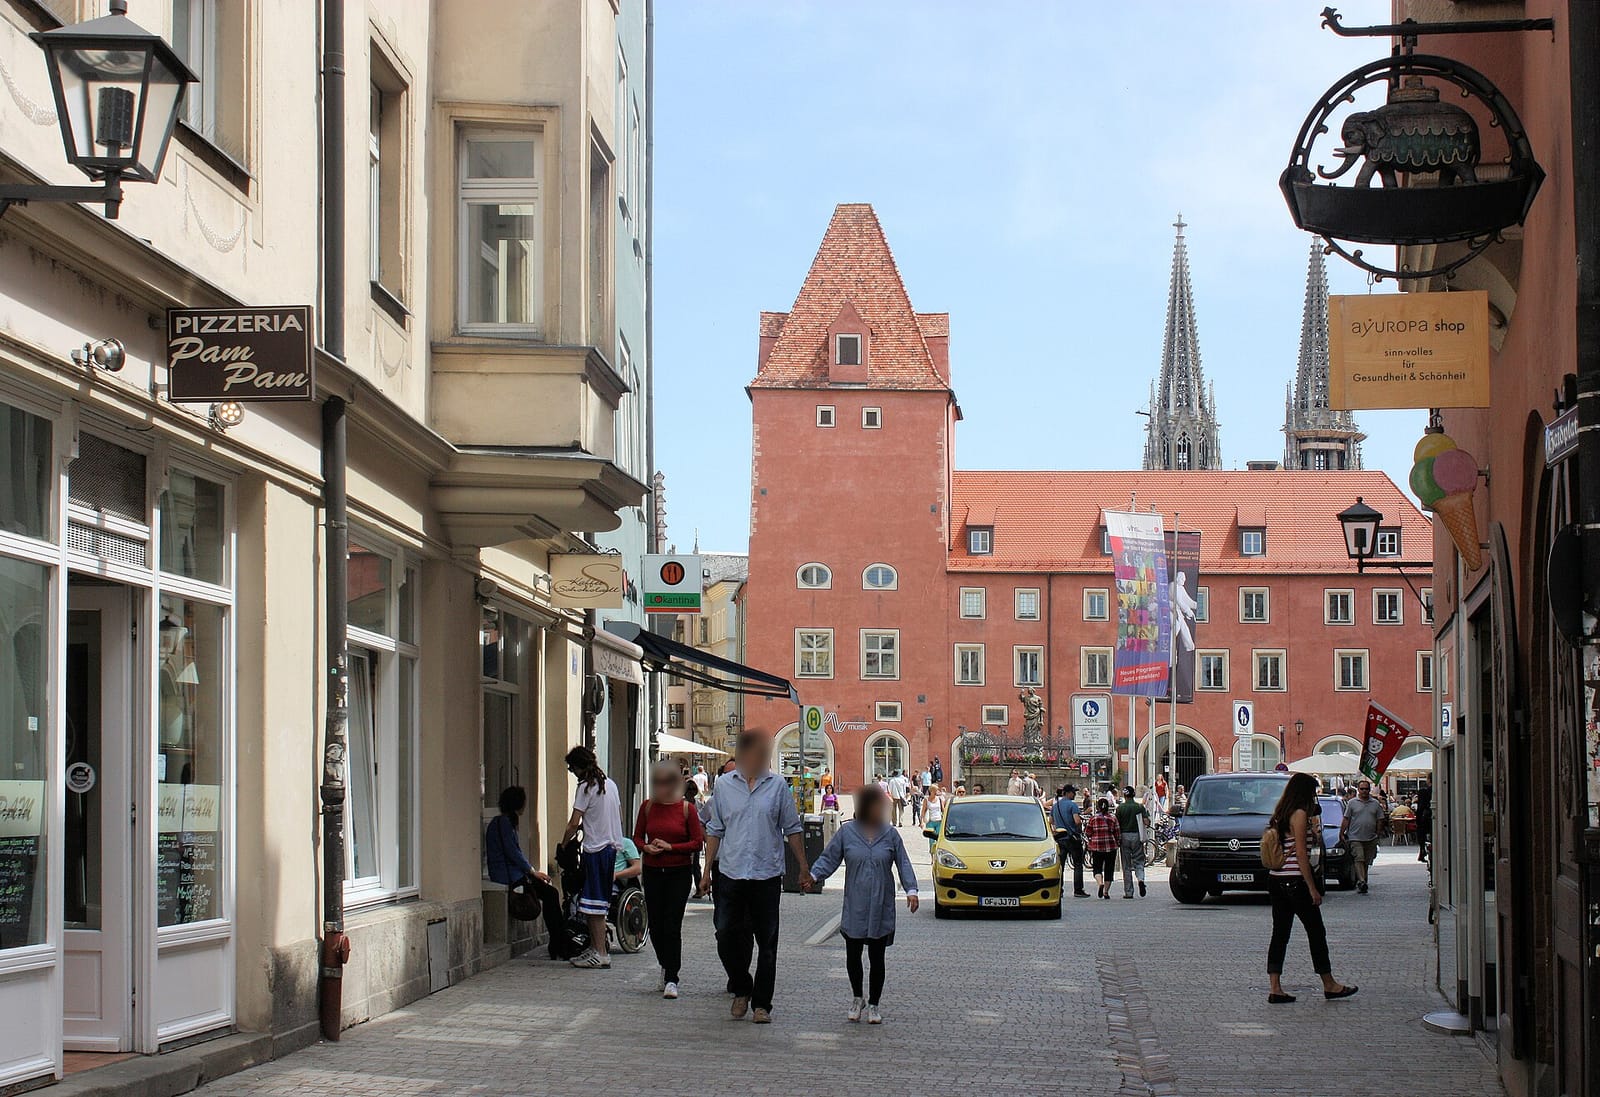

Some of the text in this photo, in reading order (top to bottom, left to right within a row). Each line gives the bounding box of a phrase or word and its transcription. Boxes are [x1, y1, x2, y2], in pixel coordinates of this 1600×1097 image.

[175, 314, 304, 334] PIZZERIA
[1434, 318, 1465, 335] shop
[169, 336, 255, 368] Pam
[1402, 359, 1415, 369] für
[223, 361, 309, 392] Pam
[1352, 370, 1466, 382] Gesundheit & Schönheit
[847, 723, 869, 731] musik
